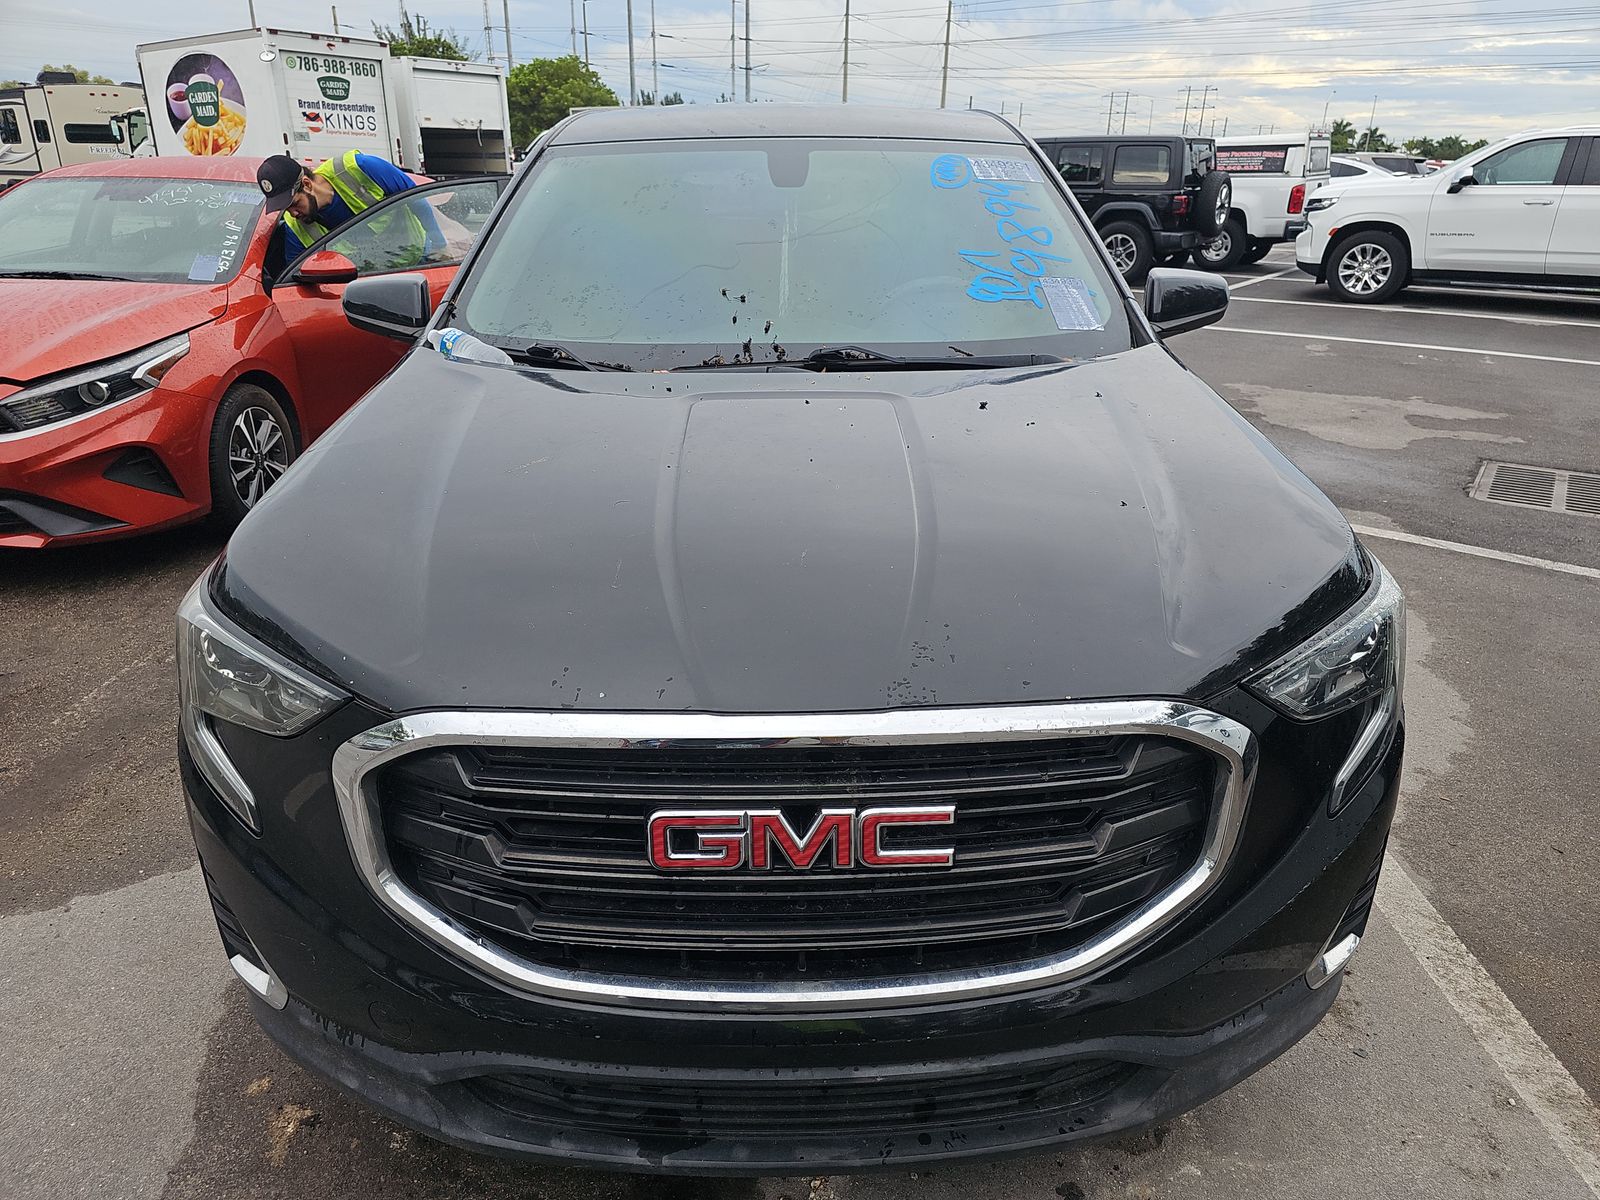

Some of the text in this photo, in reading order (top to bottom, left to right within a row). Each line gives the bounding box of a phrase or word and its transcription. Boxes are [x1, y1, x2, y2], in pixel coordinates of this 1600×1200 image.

[296, 56, 377, 78] 786-988-1860
[320, 80, 349, 89] GARDEN
[188, 91, 218, 104] GARDEN
[298, 99, 376, 113] Brand Representative
[324, 112, 377, 132] KINGS
[647, 804, 957, 871] GMC
